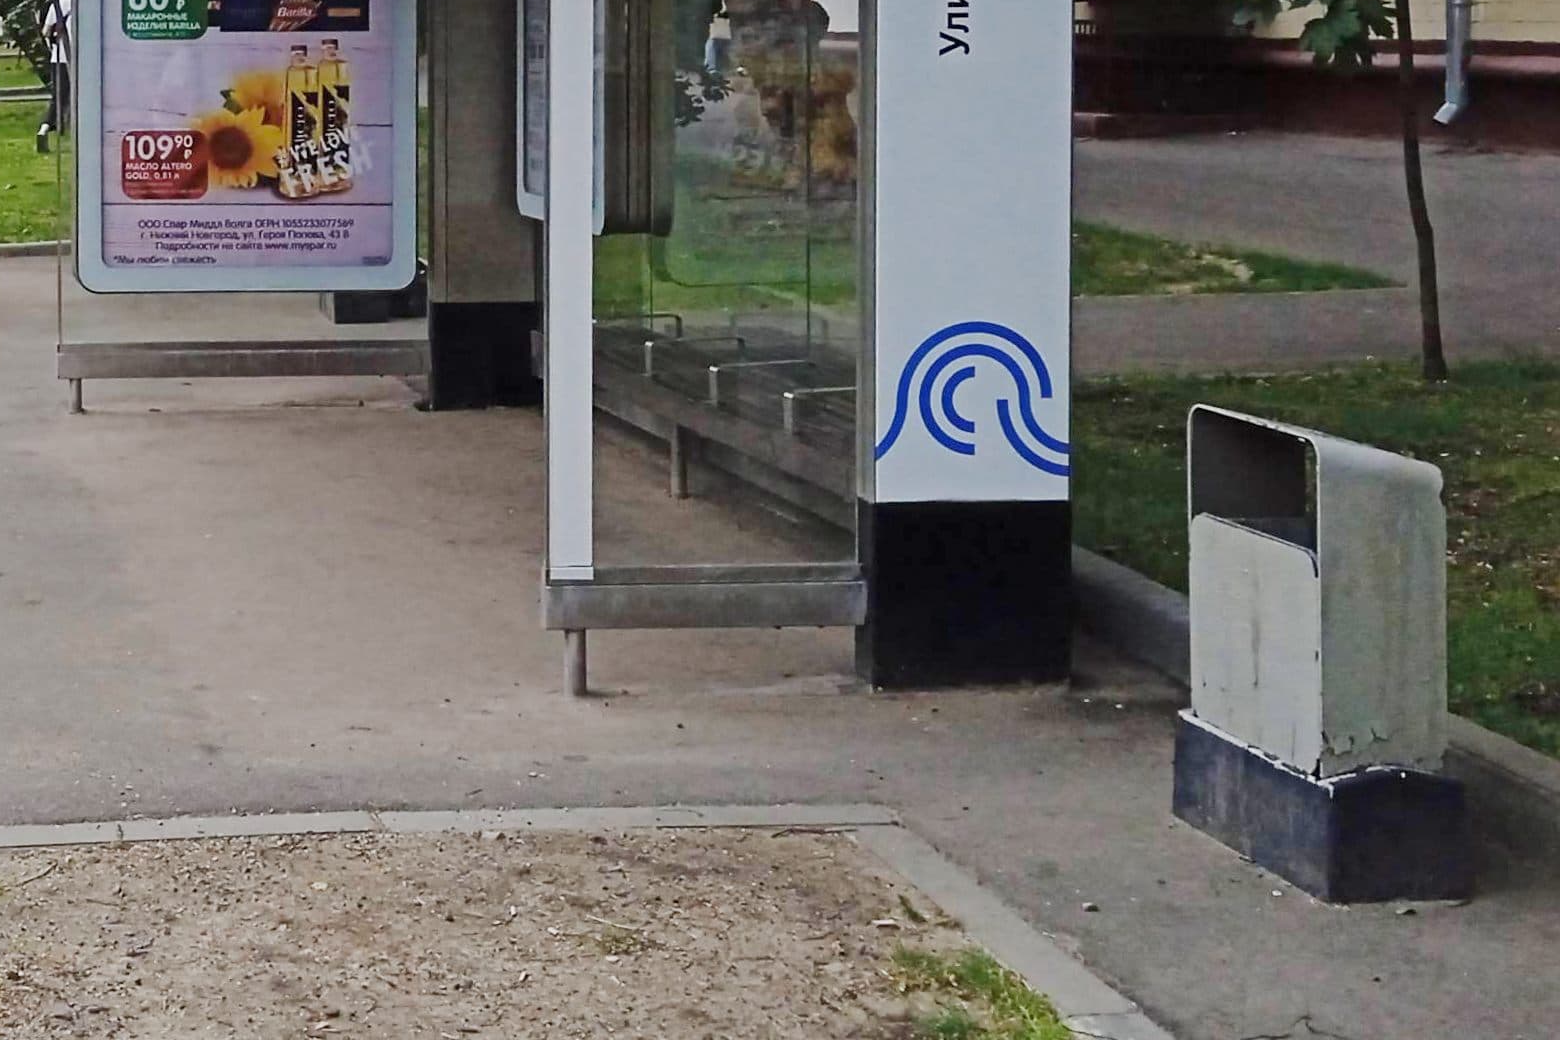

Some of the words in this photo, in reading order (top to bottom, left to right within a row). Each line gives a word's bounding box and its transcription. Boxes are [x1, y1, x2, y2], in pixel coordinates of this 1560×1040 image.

[127, 12, 188, 21] МАКАРОННЫЕ
[277, 6, 314, 17] Barilla
[127, 22, 168, 30] ИЗДЕЛИЯ
[125, 135, 174, 160] 109
[174, 135, 194, 148] 90
[125, 162, 160, 171] МАСЛО
[161, 162, 193, 170] ALTERO
[280, 144, 374, 199] FRESH
[138, 219, 161, 229] ООО
[162, 219, 188, 230] Спар
[255, 219, 280, 228] ОГРН
[259, 230, 286, 240] Героя
[155, 241, 219, 251] Подробности
[221, 242, 234, 250] на
[264, 242, 337, 251] www.myspar.ru
